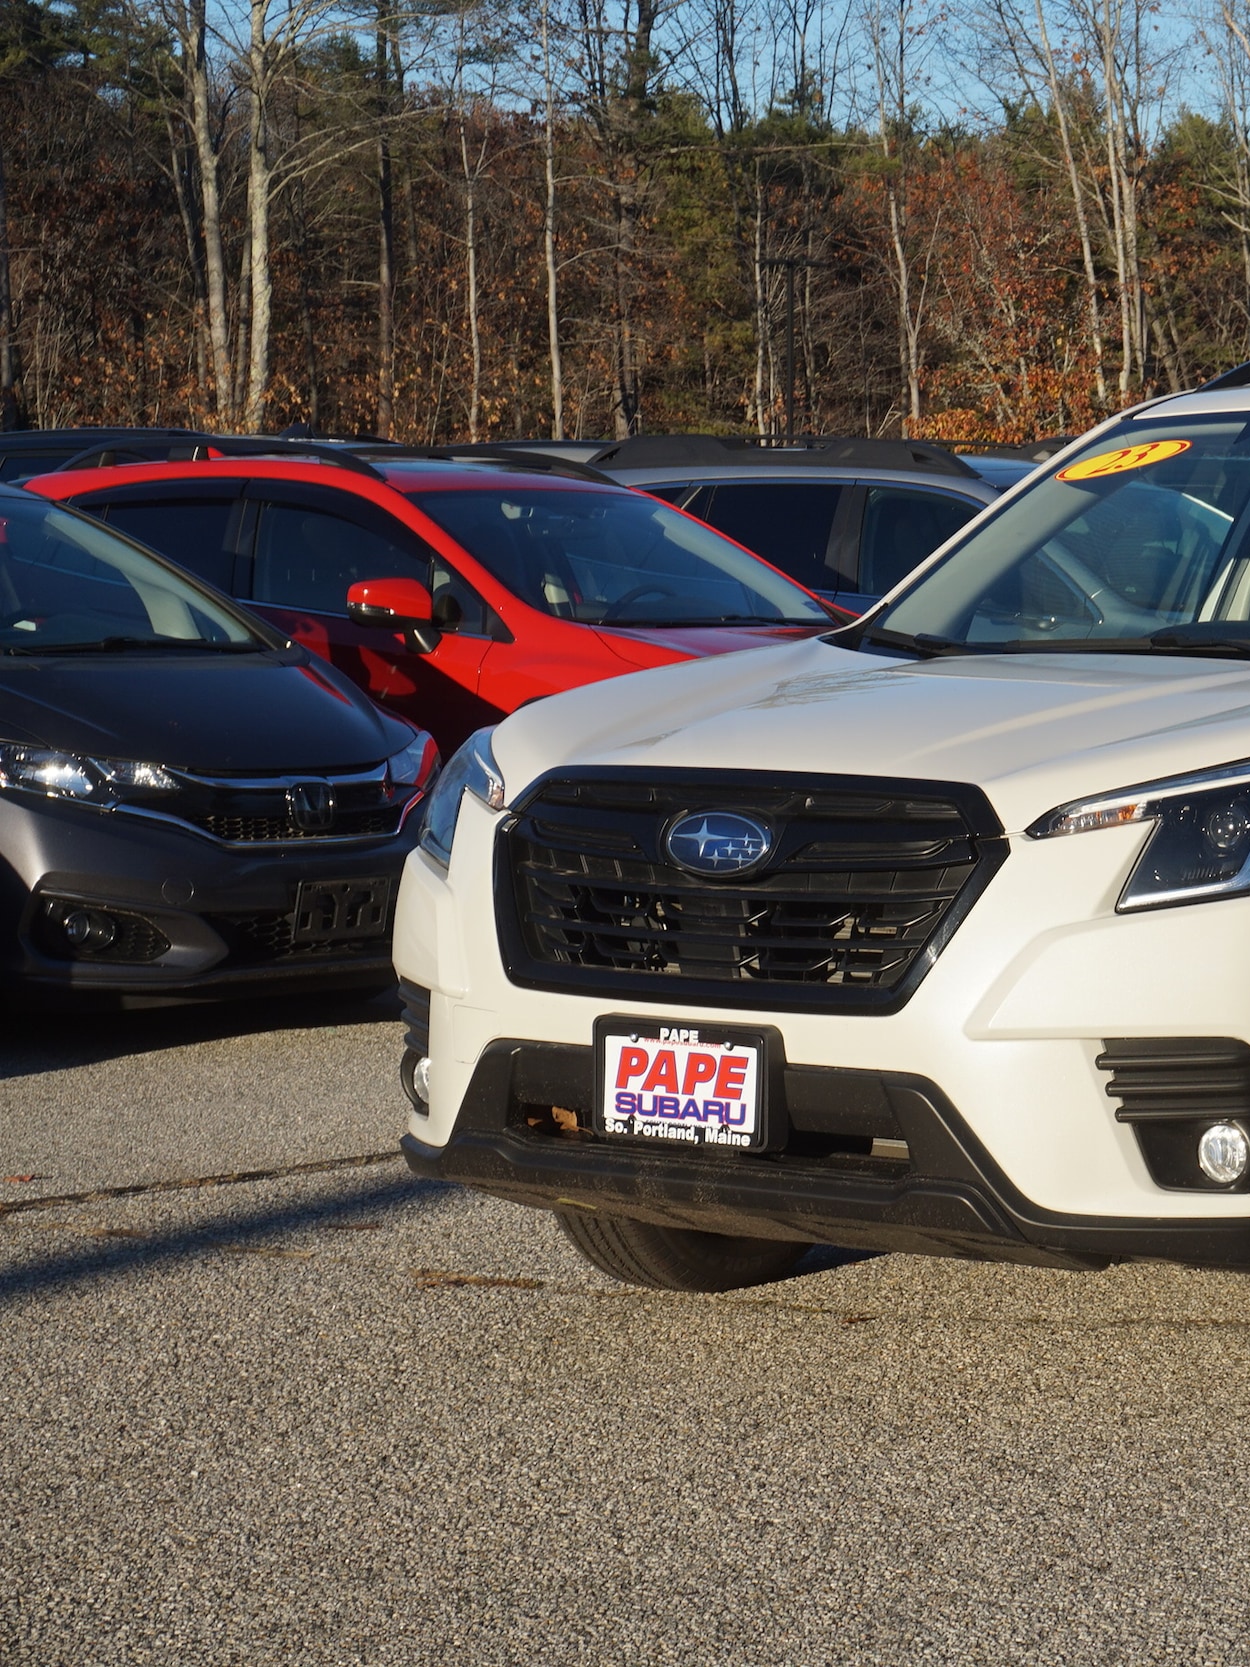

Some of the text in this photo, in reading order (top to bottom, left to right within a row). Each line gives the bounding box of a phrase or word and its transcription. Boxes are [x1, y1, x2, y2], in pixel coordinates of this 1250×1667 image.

[1086, 443, 1160, 476] 23
[660, 1027, 699, 1043] PAPE
[615, 1046, 749, 1100] PAPE
[615, 1091, 747, 1126] SUBARU
[605, 1118, 628, 1135] So.
[634, 1122, 699, 1145] Portland,
[705, 1127, 751, 1147] Maine
